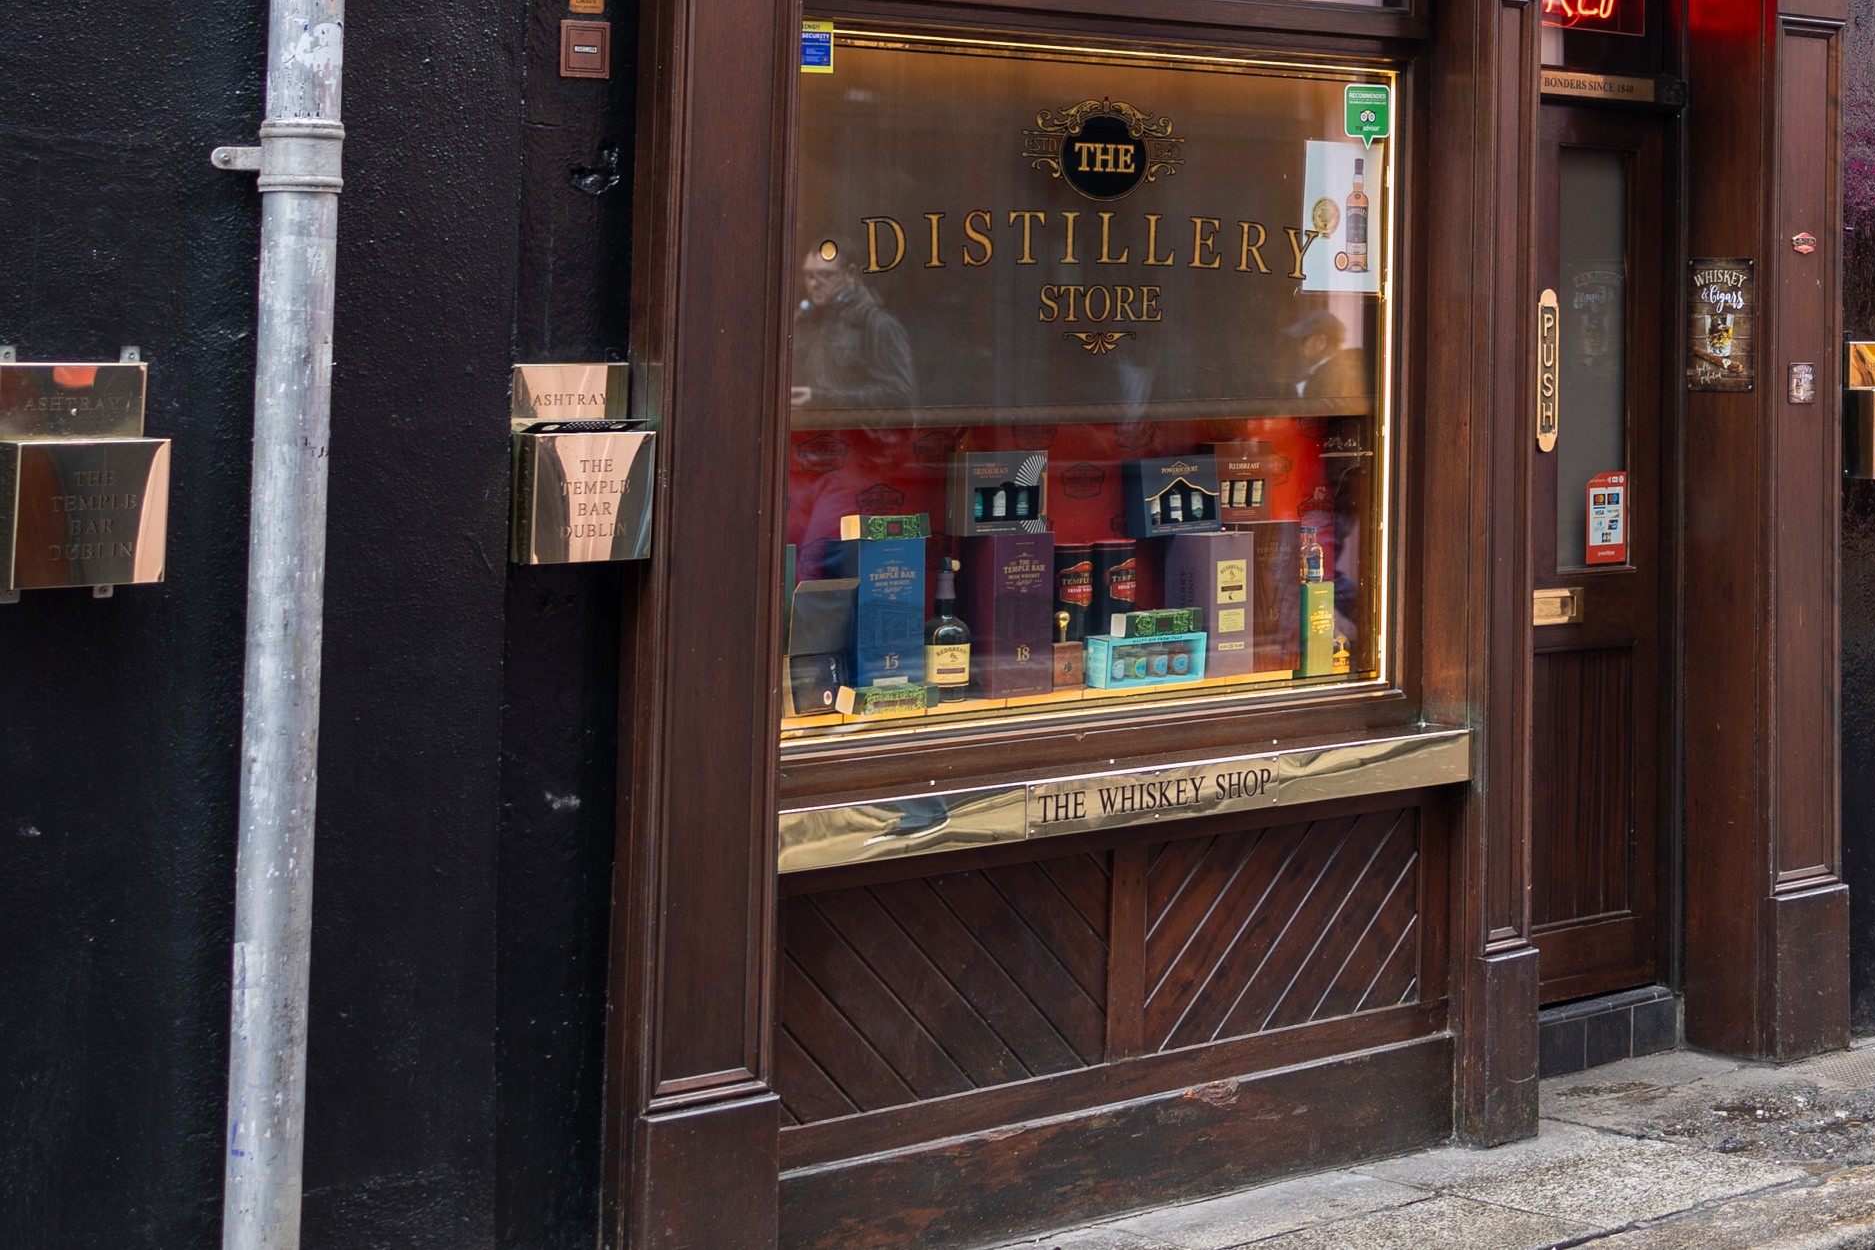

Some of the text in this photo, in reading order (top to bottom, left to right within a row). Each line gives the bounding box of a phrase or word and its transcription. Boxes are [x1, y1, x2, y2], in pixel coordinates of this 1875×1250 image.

[1544, 76, 1587, 90] BONDERS
[1588, 80, 1615, 93] SINCE
[1075, 142, 1135, 174] THE
[861, 209, 1320, 281] DISTILLERY
[1693, 269, 1748, 289] WHISKEY
[1038, 284, 1163, 324] STORE
[1710, 284, 1745, 313] Cigars
[1541, 313, 1555, 427] PUSH
[24, 396, 125, 411] ASHTRAY
[533, 393, 608, 406] ASHTRAY
[580, 459, 614, 473] THE
[74, 470, 121, 487] THE
[561, 480, 630, 496] TEMPLE
[50, 493, 137, 513] TEMPLE
[578, 502, 612, 517] BAR
[71, 517, 114, 536] BAR
[561, 523, 628, 539] DUBLIN
[48, 542, 133, 561] DUBLIN
[868, 570, 916, 581] TEMPLE BAR
[1003, 565, 1030, 574] TEMPLE
[936, 646, 968, 657] REDBREAST
[1016, 647, 1030, 662] 18
[884, 655, 899, 670] 15
[1037, 768, 1272, 824] THE WHISKEY SHOP
